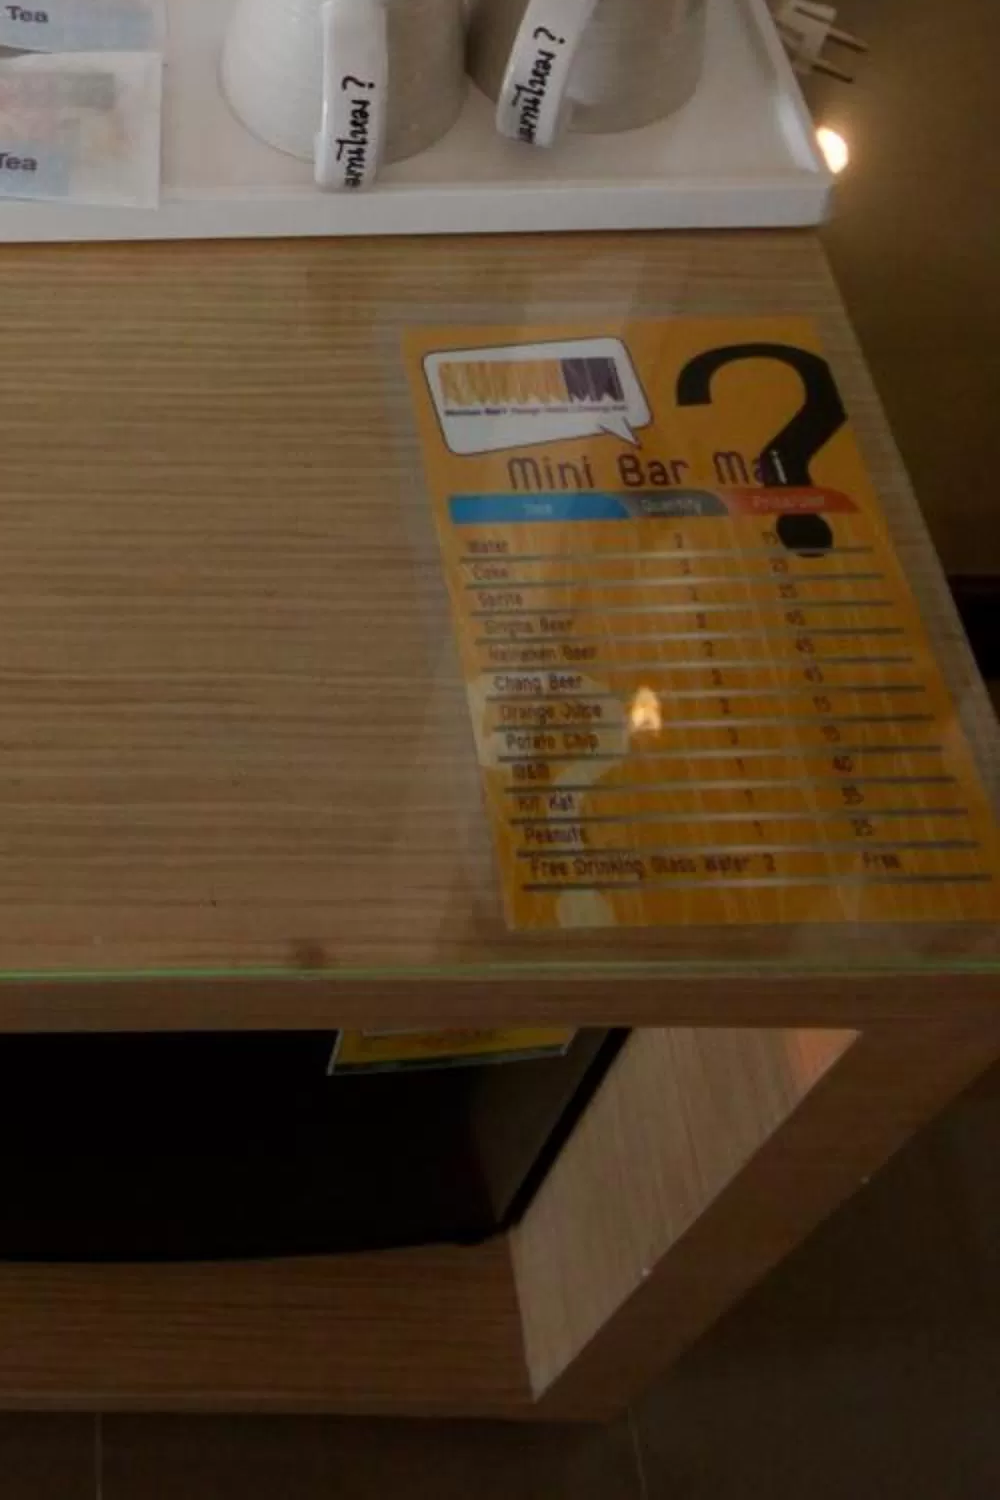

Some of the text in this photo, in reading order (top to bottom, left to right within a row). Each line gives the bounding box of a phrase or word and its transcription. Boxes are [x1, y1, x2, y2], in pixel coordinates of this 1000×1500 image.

[6, 4, 49, 24] Tea
[507, 455, 595, 491] Mini
[617, 453, 690, 487] Bar
[540, 616, 575, 632] Beer
[561, 644, 597, 661] Beer
[493, 674, 542, 695] Chang
[549, 672, 583, 690] Beer
[502, 703, 554, 726] Orange
[560, 702, 603, 719] Juice
[506, 732, 556, 750] Potato
[563, 731, 599, 752] Chip
[531, 854, 568, 876] Free
[573, 855, 645, 881] Drinking
